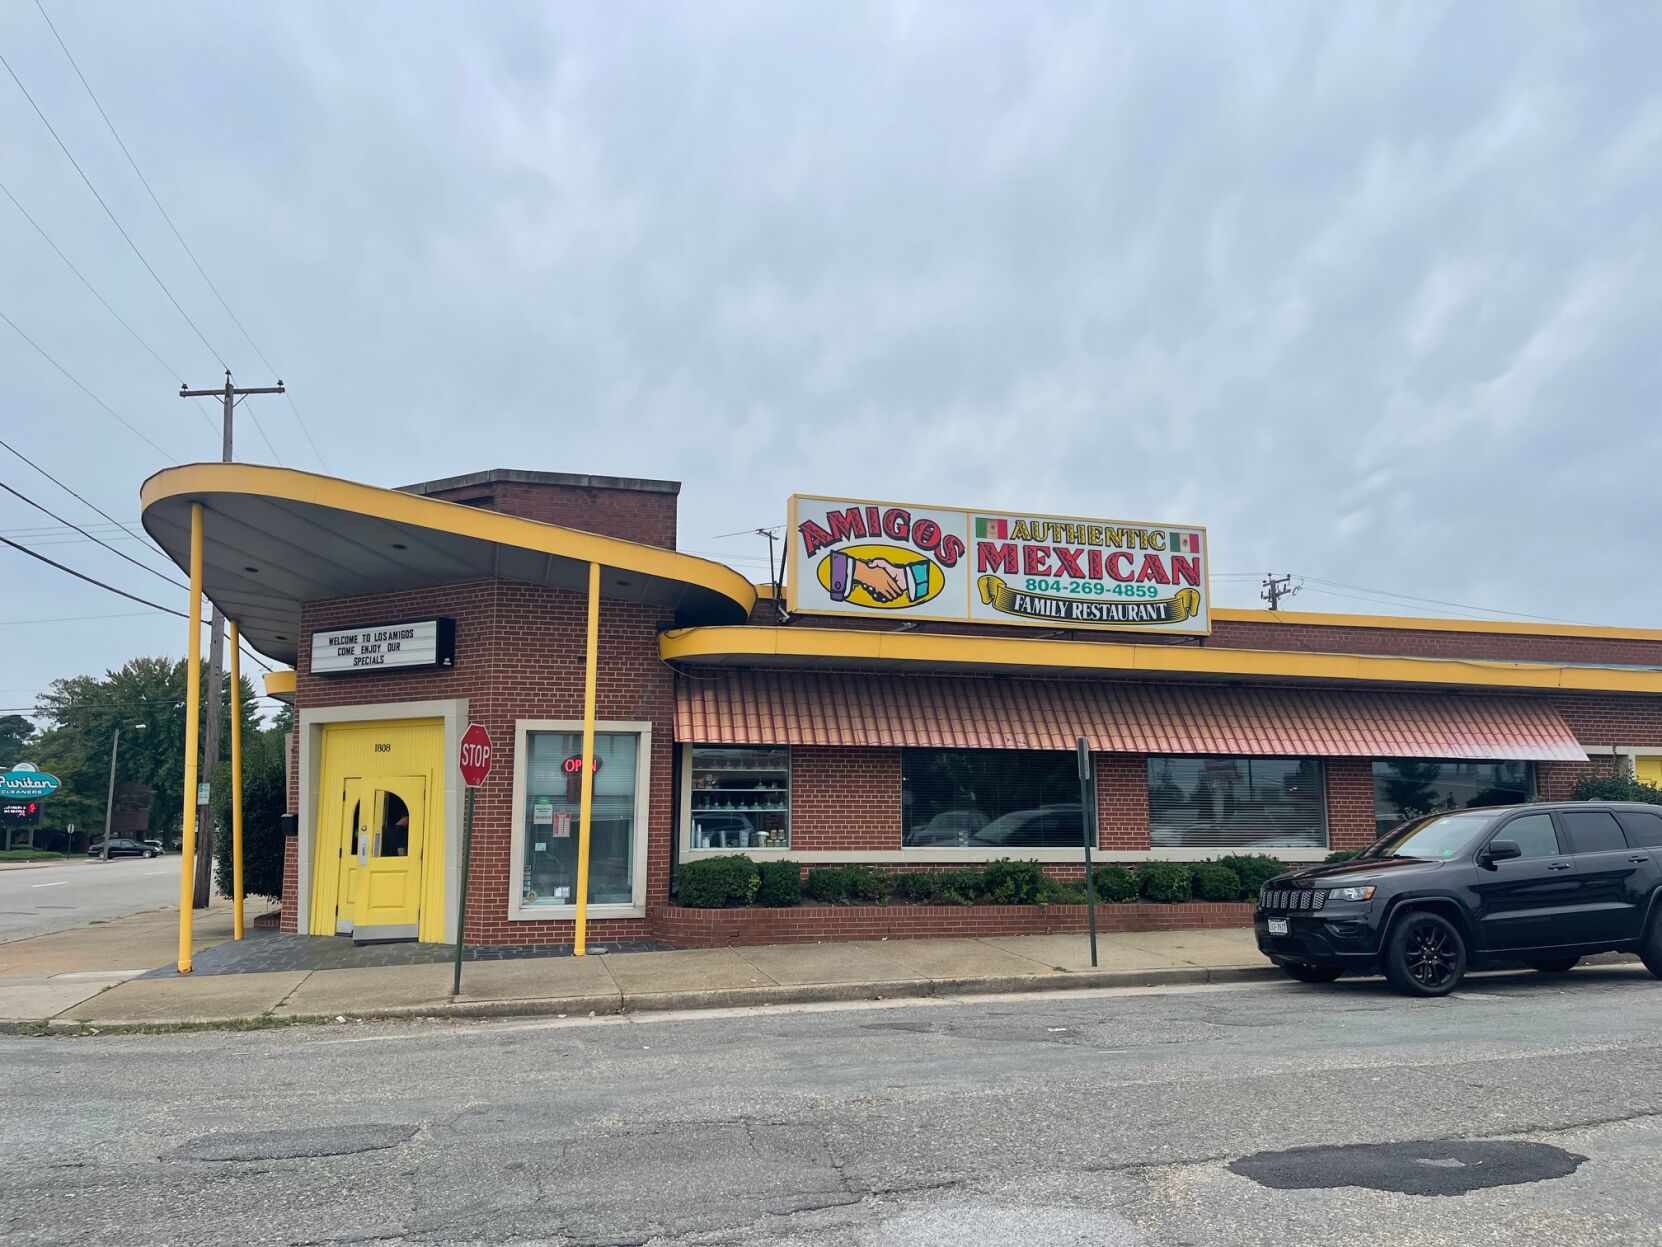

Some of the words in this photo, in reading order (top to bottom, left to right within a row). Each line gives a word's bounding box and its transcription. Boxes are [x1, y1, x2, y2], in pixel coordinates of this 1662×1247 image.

[798, 505, 966, 570] AMIGOS
[1010, 519, 1166, 551] AUTHENTIC
[976, 541, 1201, 586] MEXICAN
[1025, 578, 1159, 599] 804-269-4859
[1013, 597, 1068, 618] FAMILY
[1071, 601, 1168, 621] RESTAURANT
[328, 635, 358, 646] WELCOME
[362, 633, 370, 643] TO
[337, 646, 355, 656] COME
[361, 643, 382, 654] ENJOY
[387, 642, 400, 652] OUR
[353, 655, 385, 666] SPECIALS
[374, 743, 391, 752] 1808
[461, 743, 490, 767] STOP
[564, 759, 597, 772] OPN
